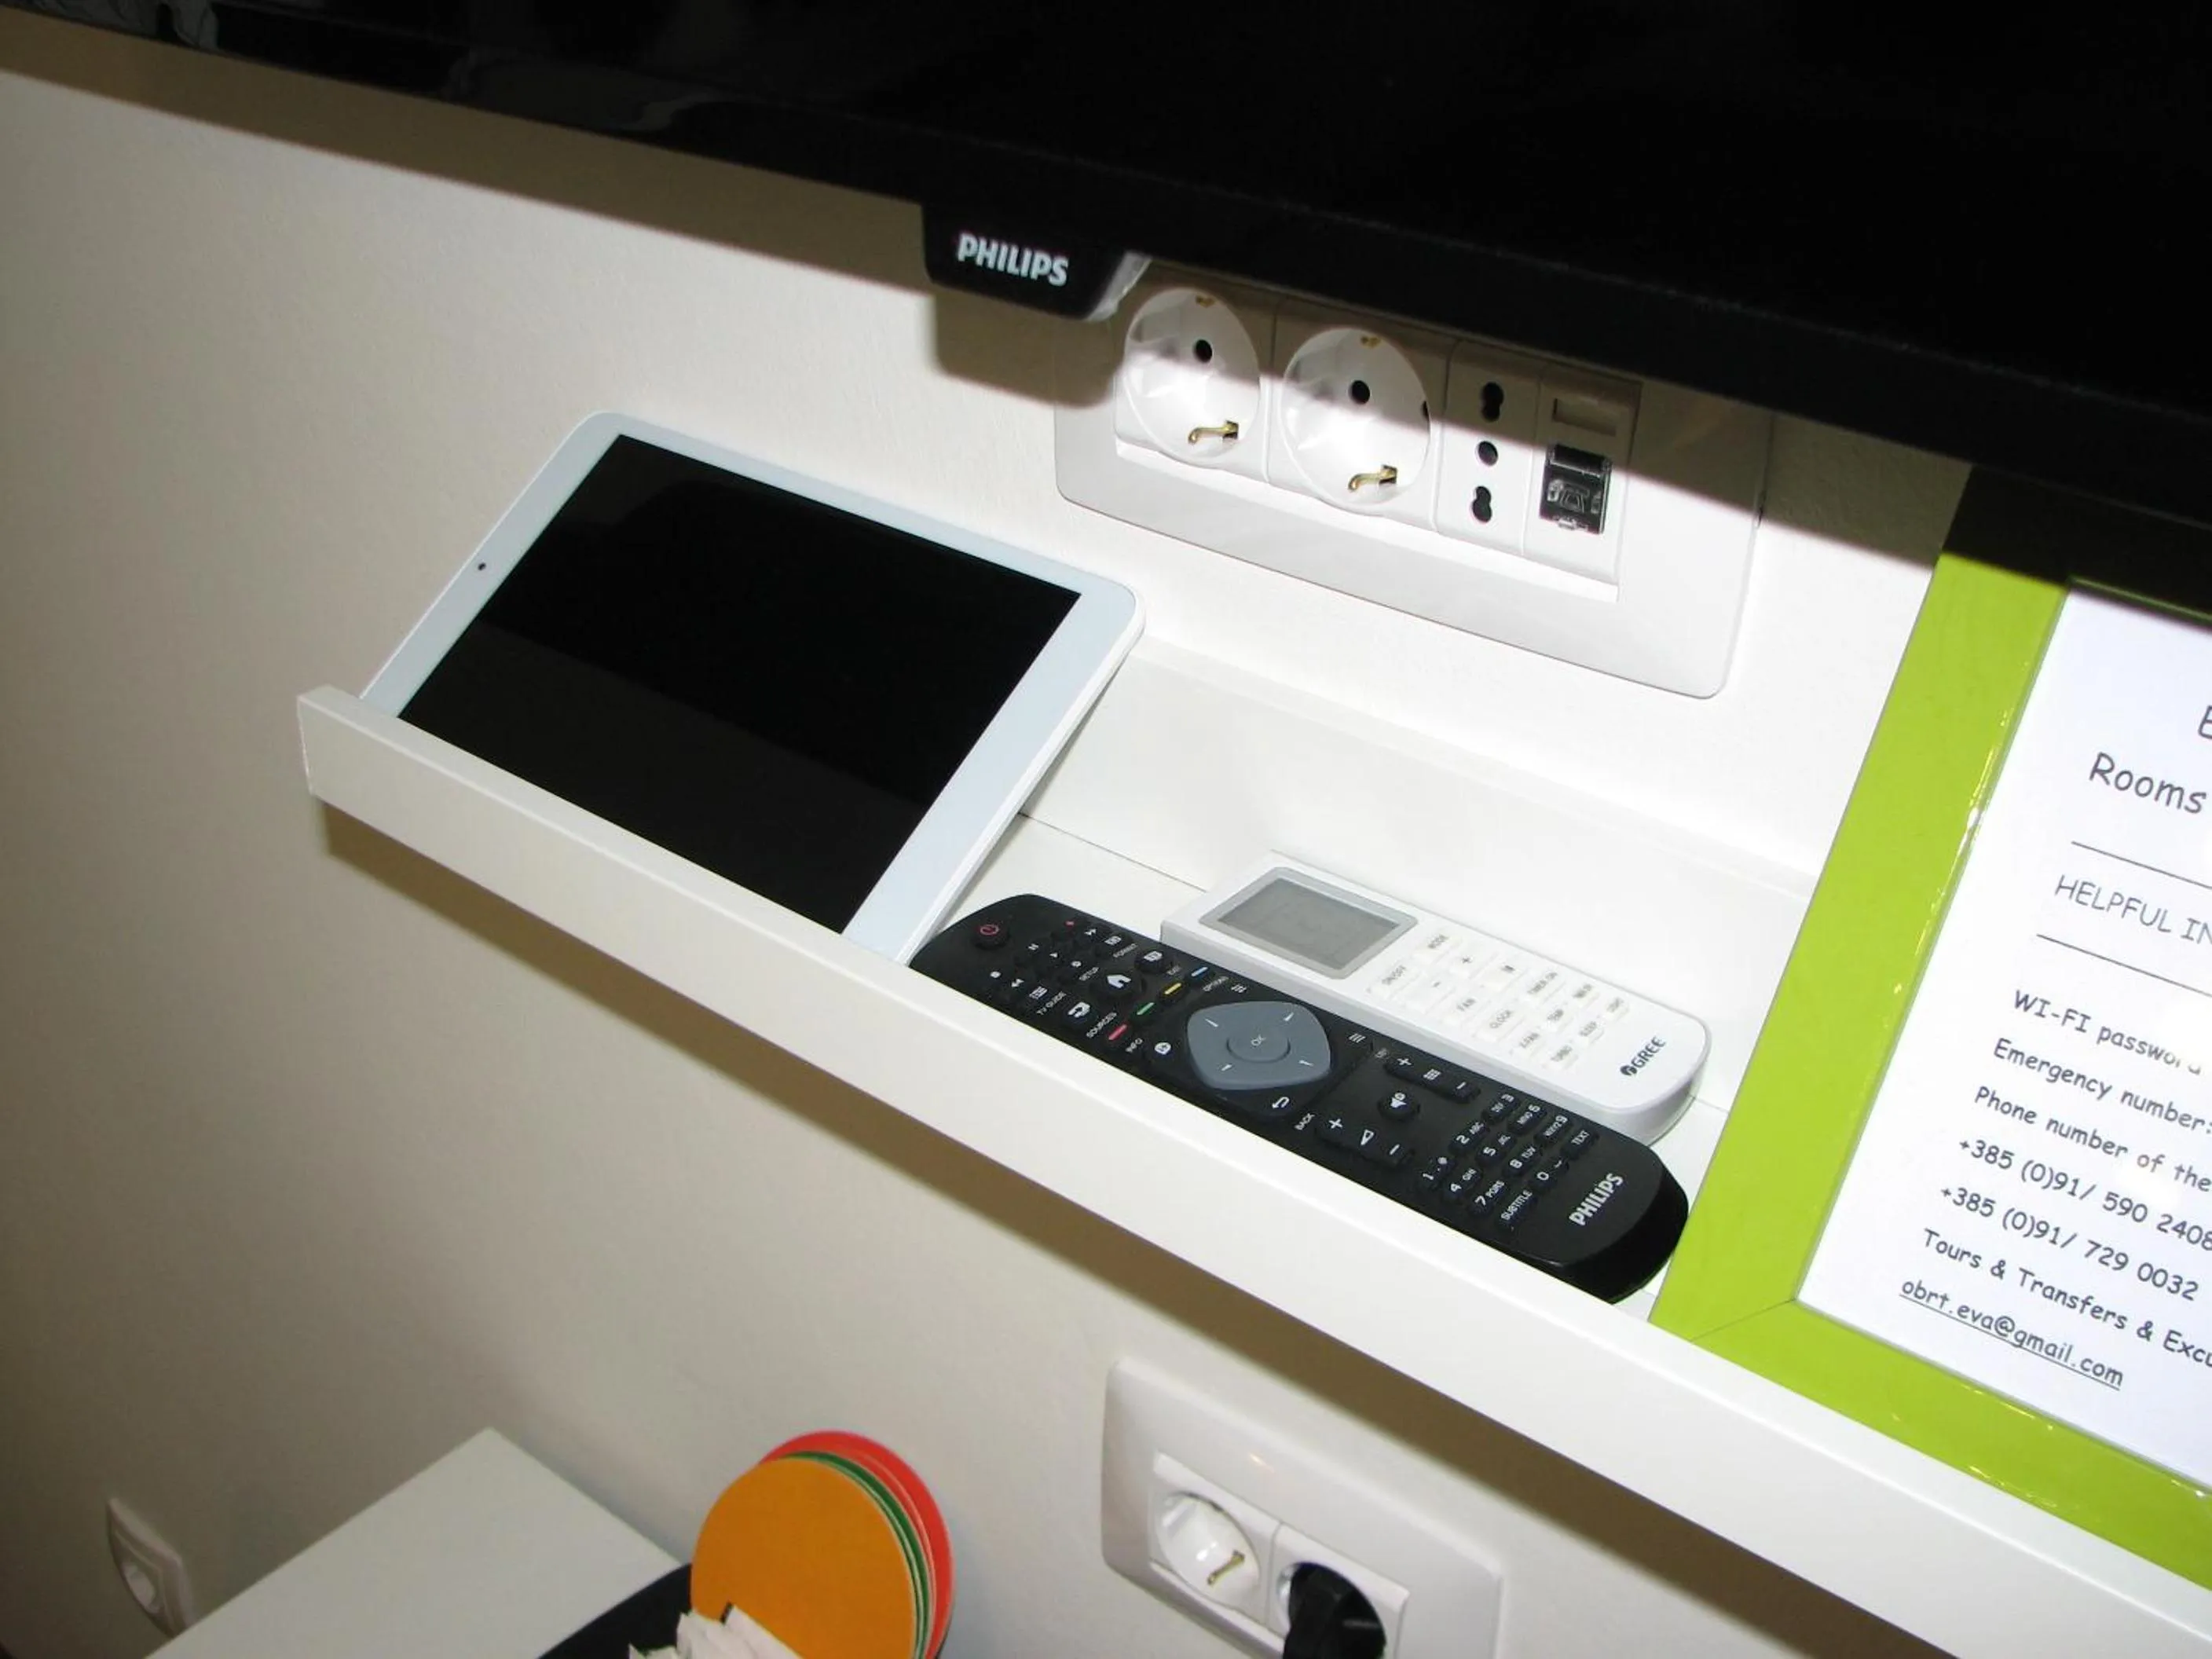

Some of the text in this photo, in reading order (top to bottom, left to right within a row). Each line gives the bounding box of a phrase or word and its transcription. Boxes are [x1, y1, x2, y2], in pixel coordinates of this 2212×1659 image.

[957, 233, 1068, 287] PHILIPS
[2089, 751, 2207, 815] Rooms
[2054, 874, 2172, 933] HELPFUL
[2014, 989, 2092, 1034] WI-FI
[1630, 1035, 1666, 1068] GREE
[1993, 1037, 2113, 1101] Emergency
[1456, 1133, 1470, 1144] 2
[1482, 1146, 1497, 1157] 5
[1509, 1158, 1523, 1169] 8
[1974, 1086, 2212, 1192] Phone number of the
[1450, 1182, 1462, 1192] 4
[1474, 1194, 1487, 1207] 7
[1569, 1173, 1624, 1227] PHILIPS
[1959, 1139, 2212, 1251] +385 (0)91/ 590 2408
[1940, 1187, 2199, 1302] +385 (0)91/ 729 0032
[1924, 1227, 1983, 1269] Tours
[1990, 1258, 2007, 1280] &
[2018, 1267, 2129, 1330] Transfers
[2136, 1320, 2155, 1342] &
[1901, 1280, 2124, 1389] obrt.eva@gmail.com
